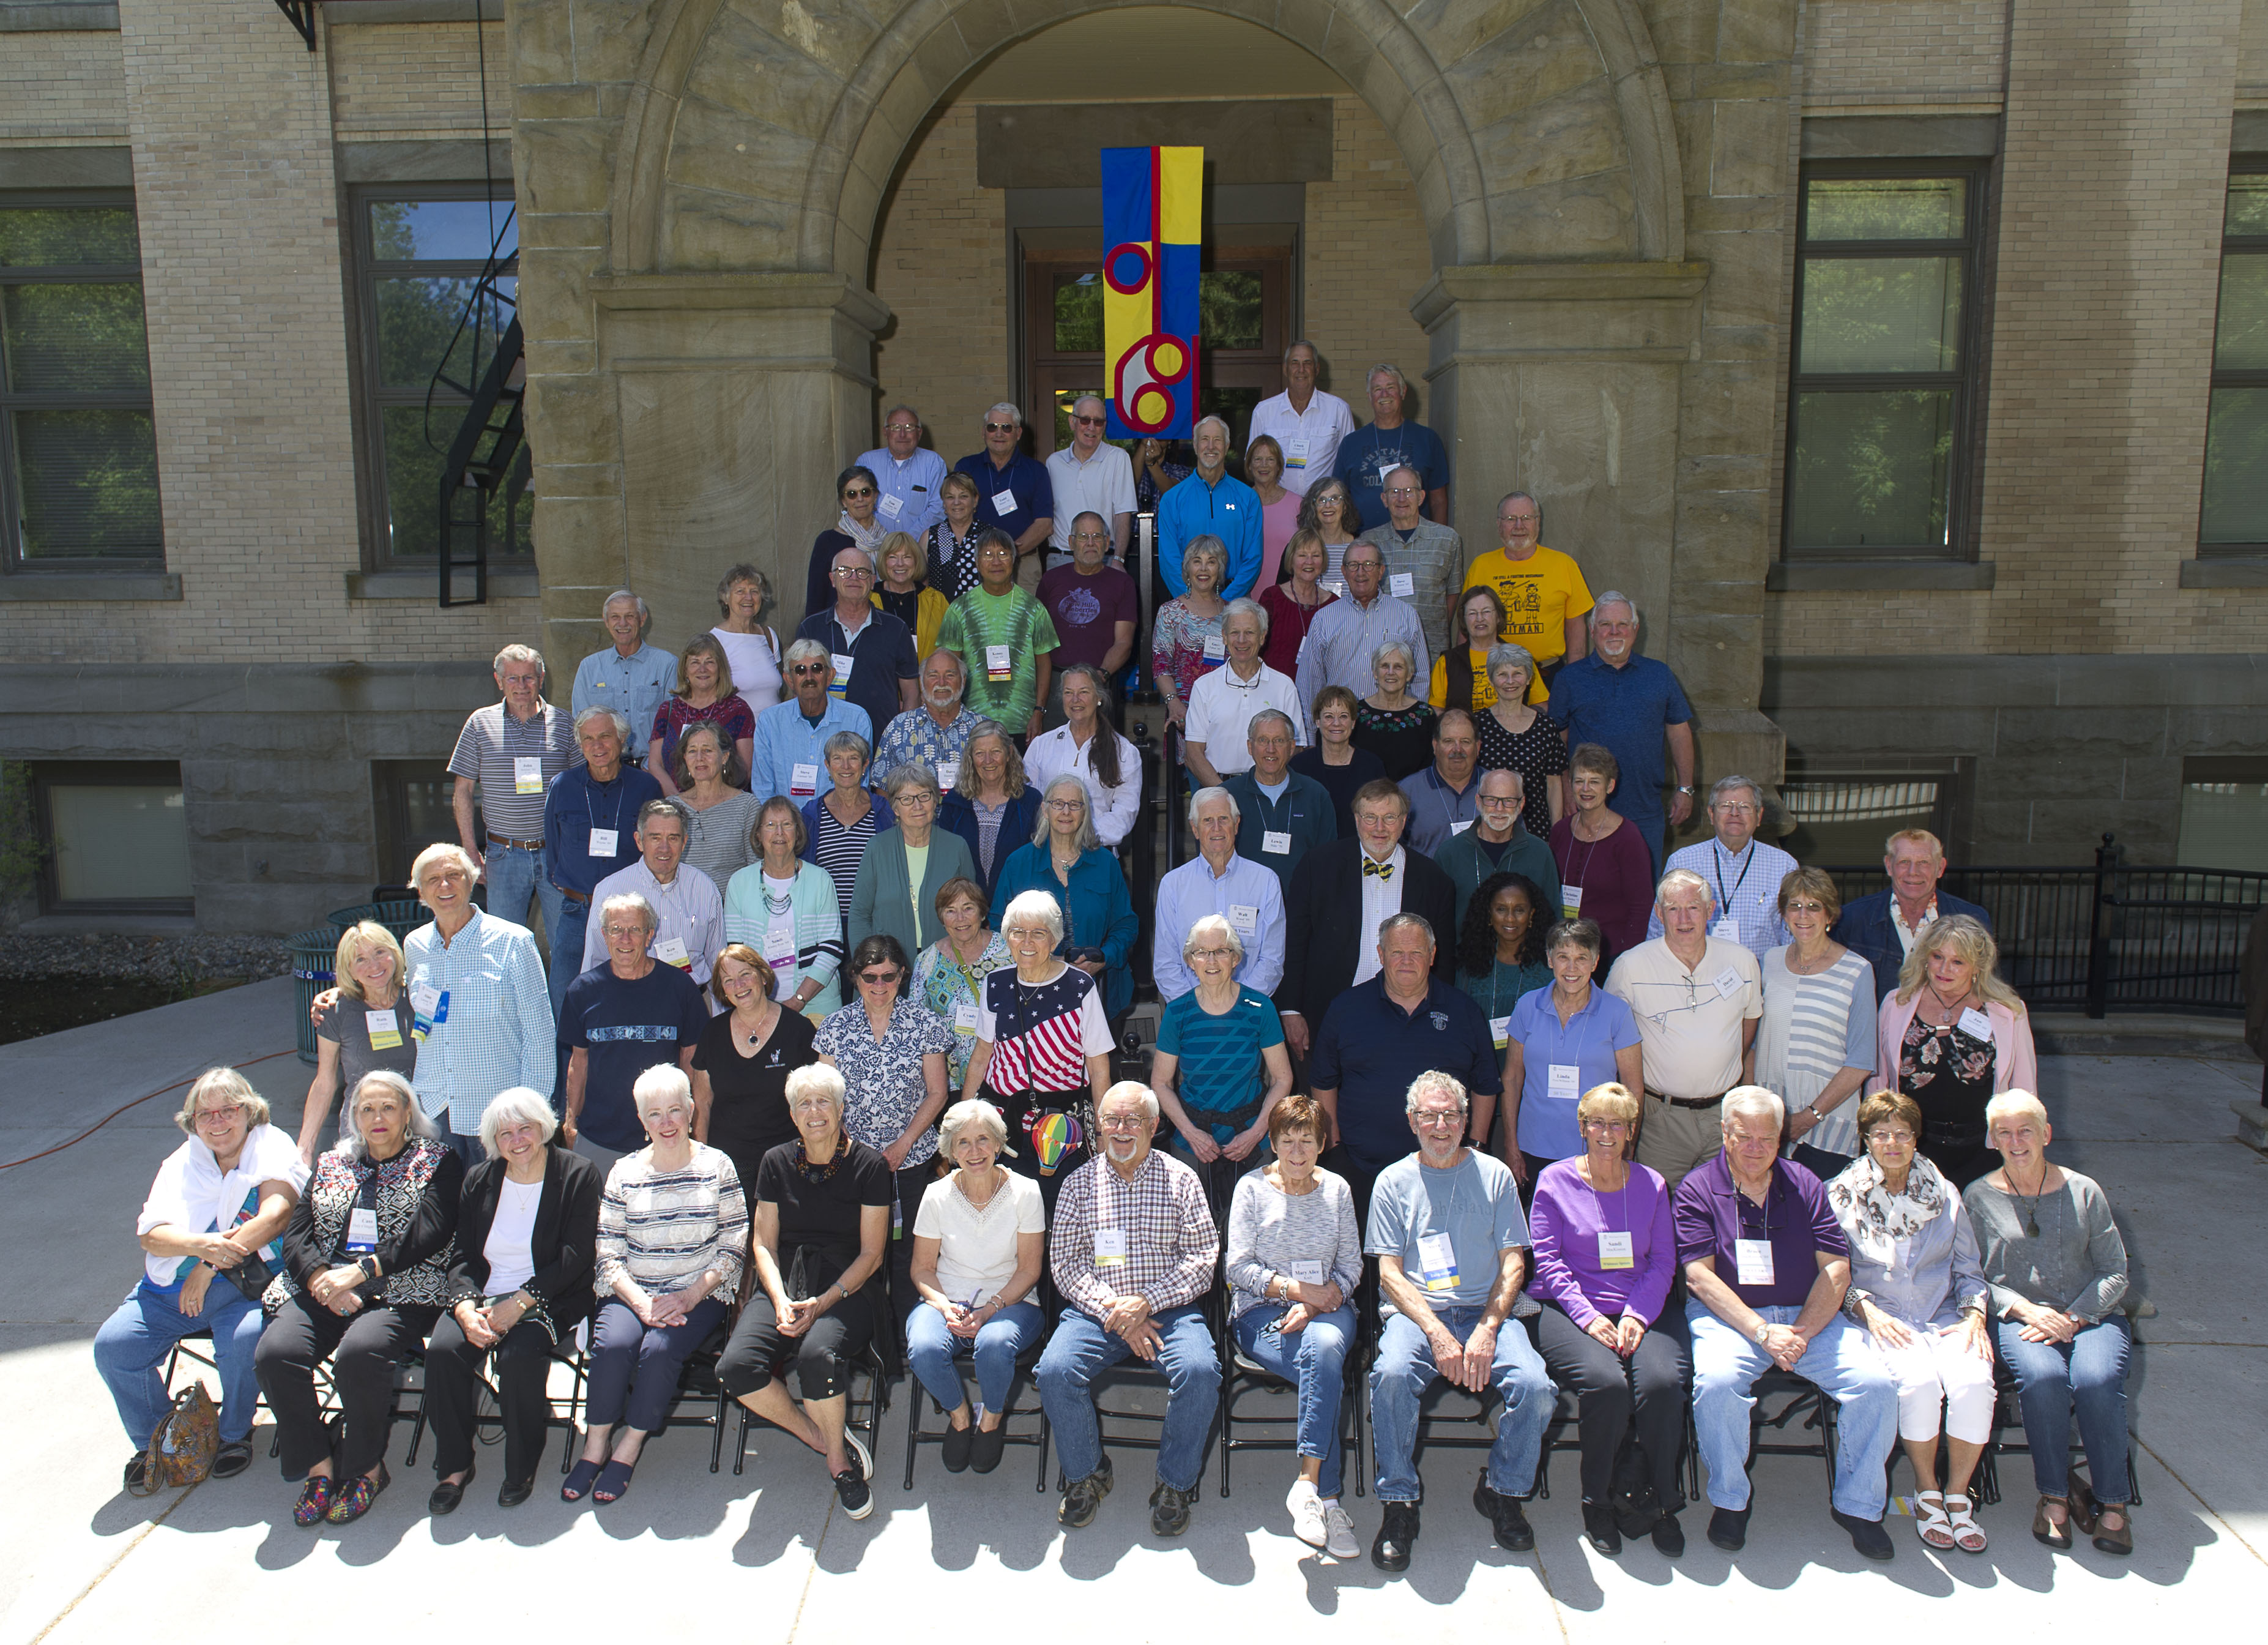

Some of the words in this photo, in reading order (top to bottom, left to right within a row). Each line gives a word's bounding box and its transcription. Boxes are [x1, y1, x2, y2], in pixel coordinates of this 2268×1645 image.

[1502, 625, 1539, 634] HITMAN
[1723, 977, 1733, 987] David
[1452, 1198, 1493, 1217] island
